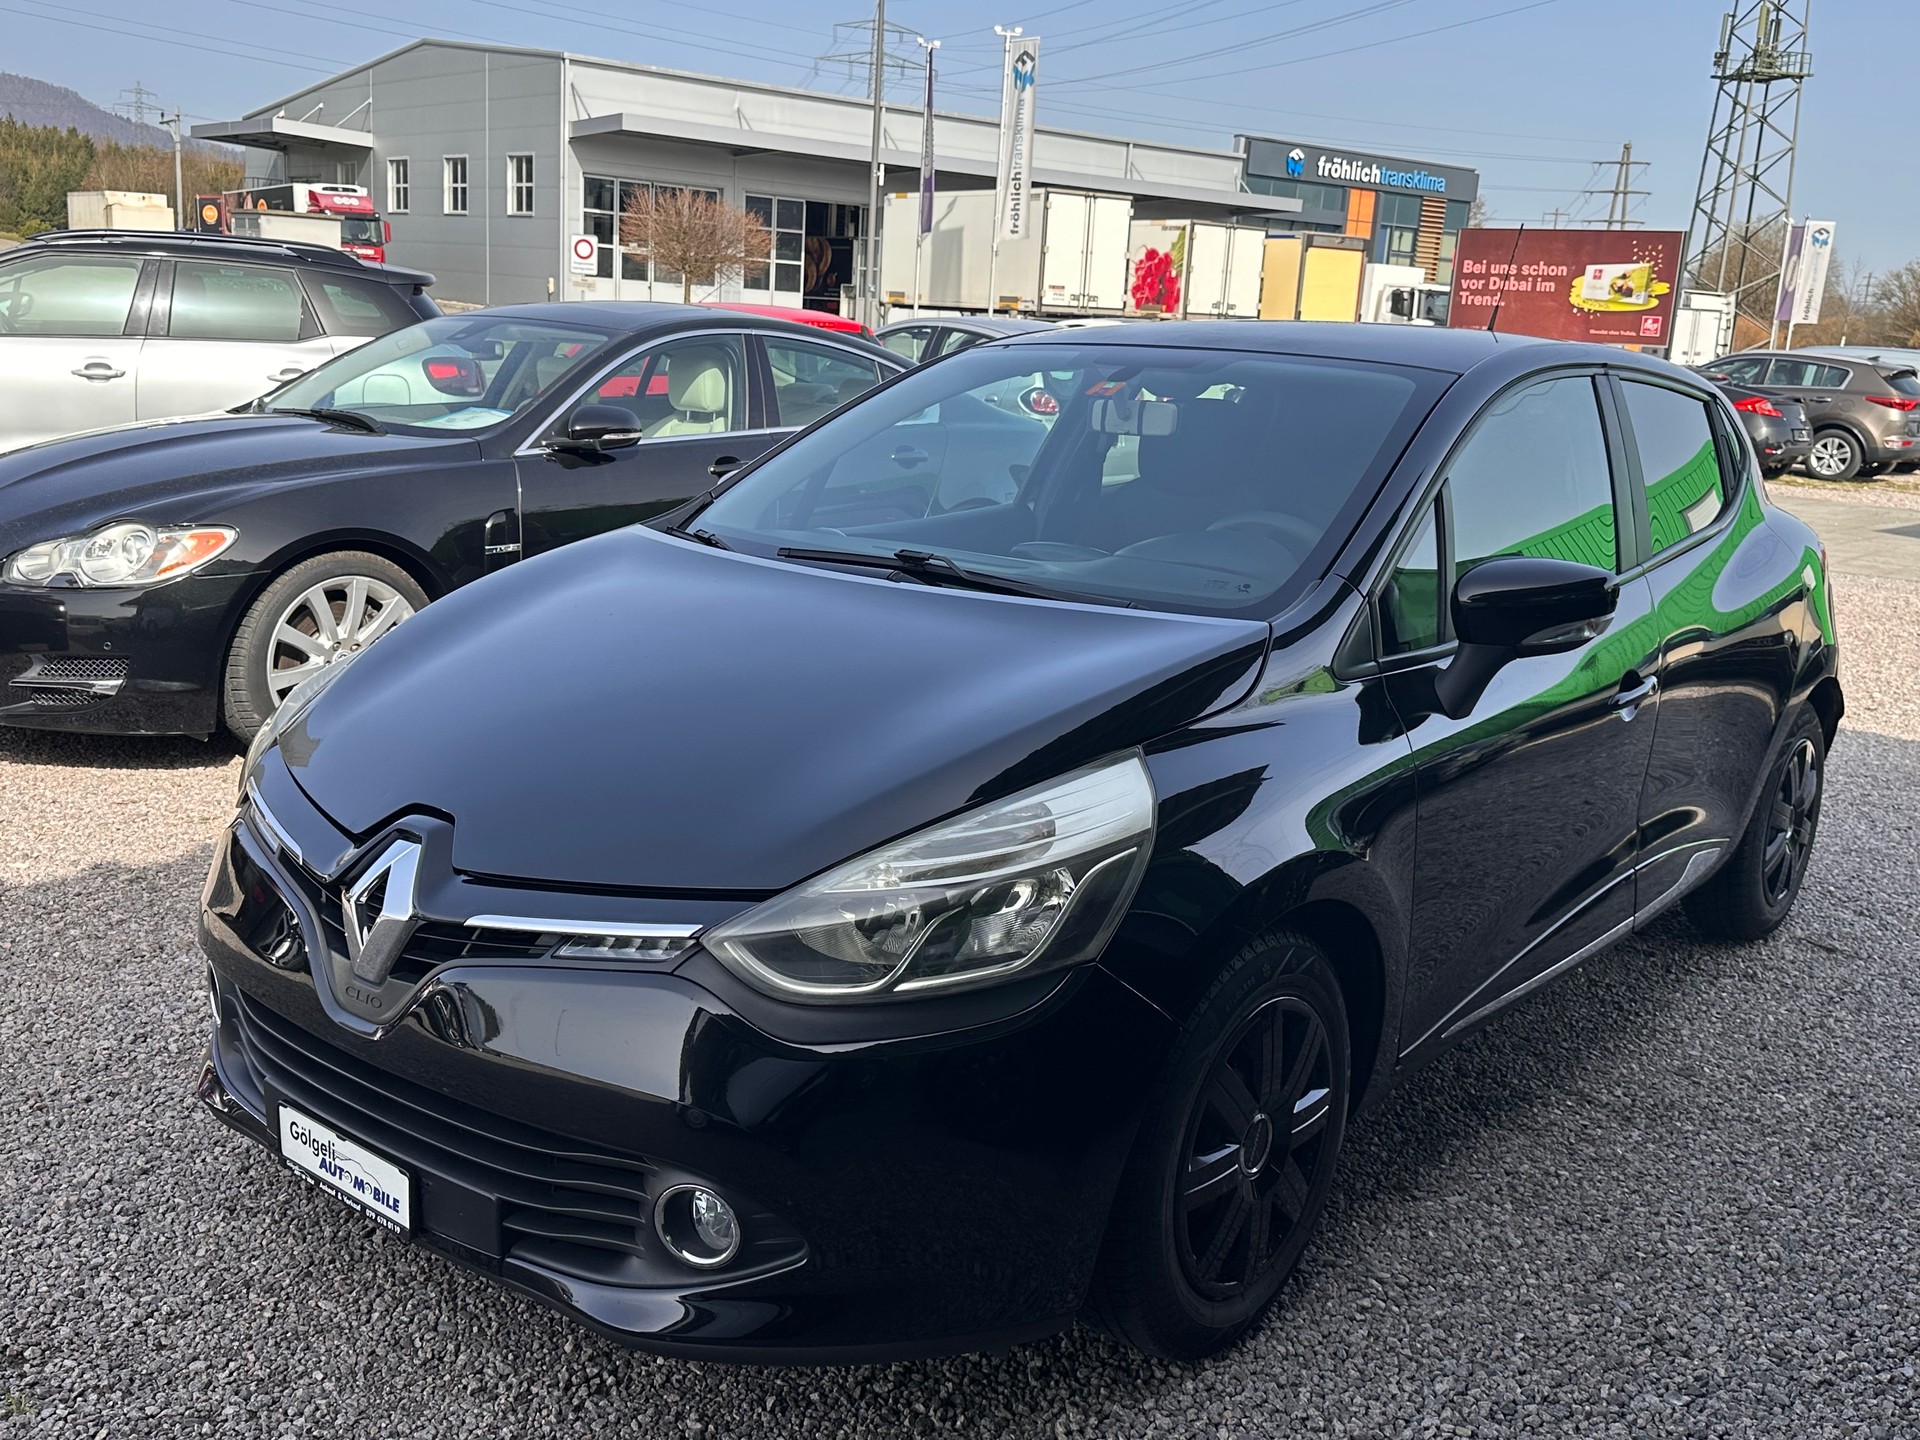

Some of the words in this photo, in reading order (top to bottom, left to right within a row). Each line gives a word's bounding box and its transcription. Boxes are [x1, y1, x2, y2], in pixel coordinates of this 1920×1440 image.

[1317, 155, 1446, 193] fröhlichtransklima
[1462, 259, 1487, 275] Bei
[1490, 262, 1517, 276] uns
[1521, 260, 1568, 277] schon
[1460, 278, 1485, 290] vor
[1488, 276, 1531, 292] Dubai
[1535, 277, 1556, 293] im
[1459, 291, 1506, 307] Trend.
[345, 985, 382, 1009] CLIO
[289, 1120, 336, 1162] Gölgeli
